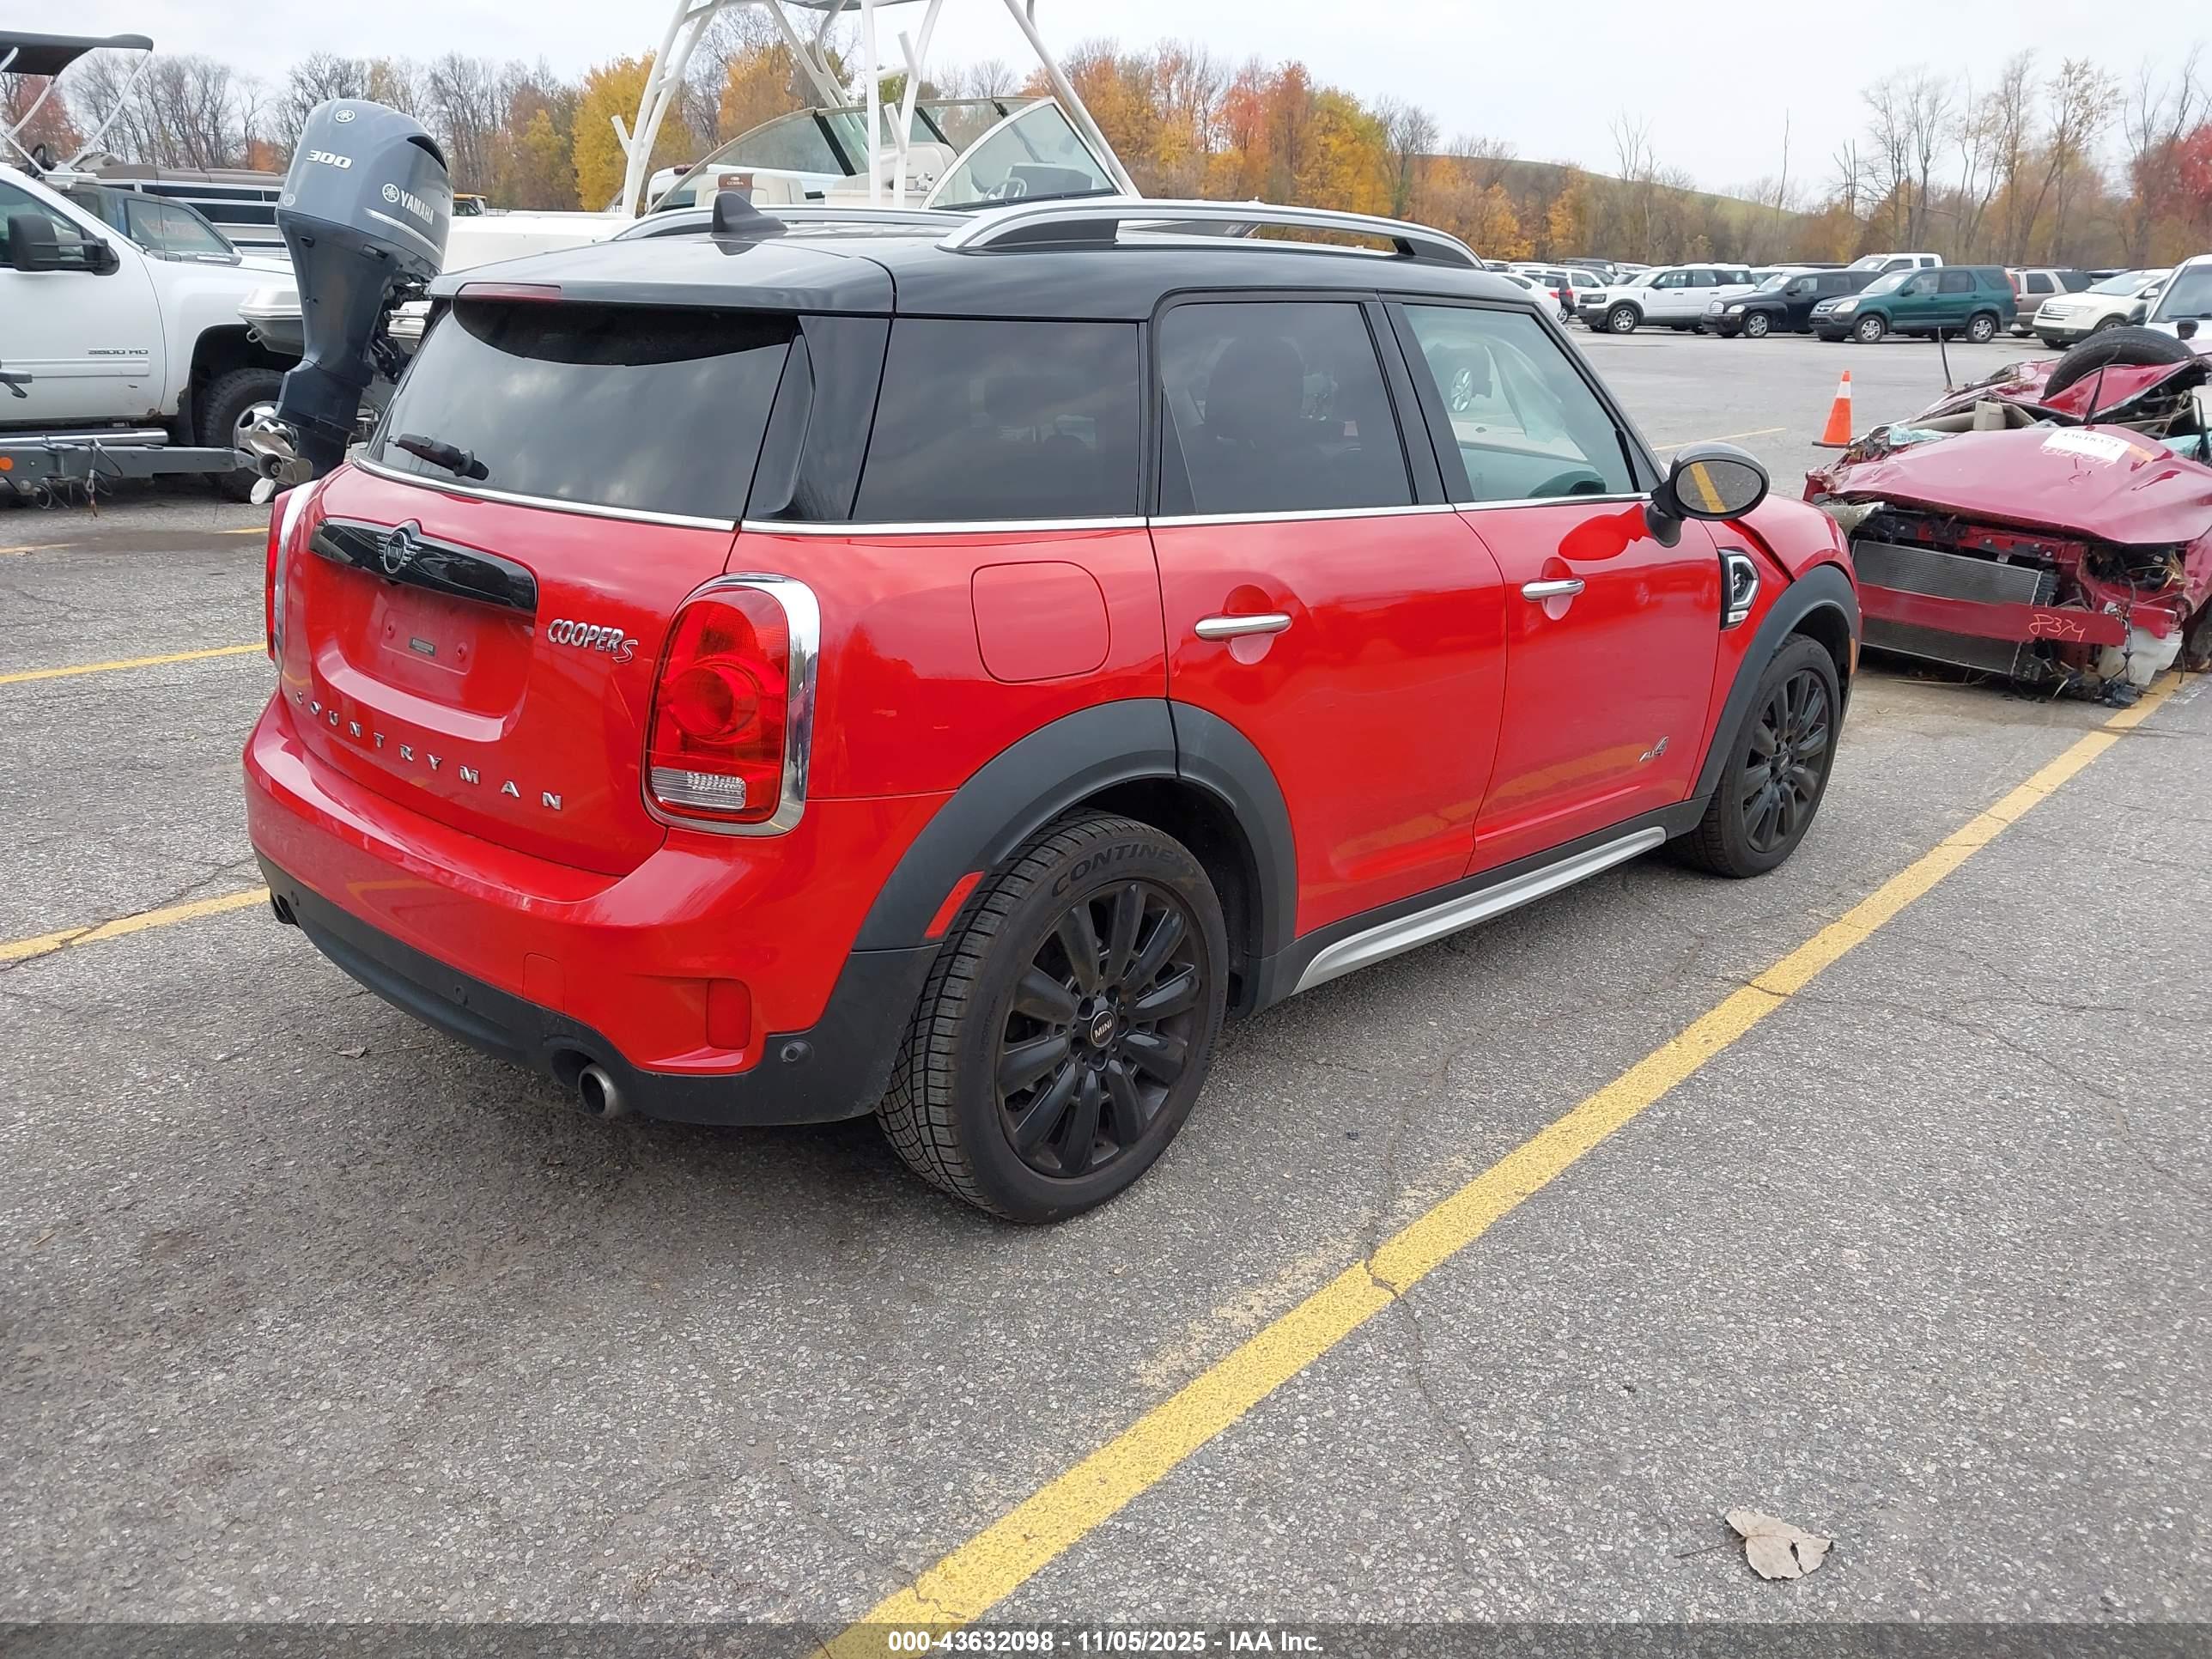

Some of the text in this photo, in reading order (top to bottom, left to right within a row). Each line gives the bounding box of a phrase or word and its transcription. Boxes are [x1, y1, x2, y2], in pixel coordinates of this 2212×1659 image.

[306, 149, 354, 170] 300
[400, 190, 434, 226] YAMAHA
[386, 544, 403, 560] MINI
[295, 690, 562, 811] COUNTRYMAN
[1094, 1018, 1113, 1038] MINI
